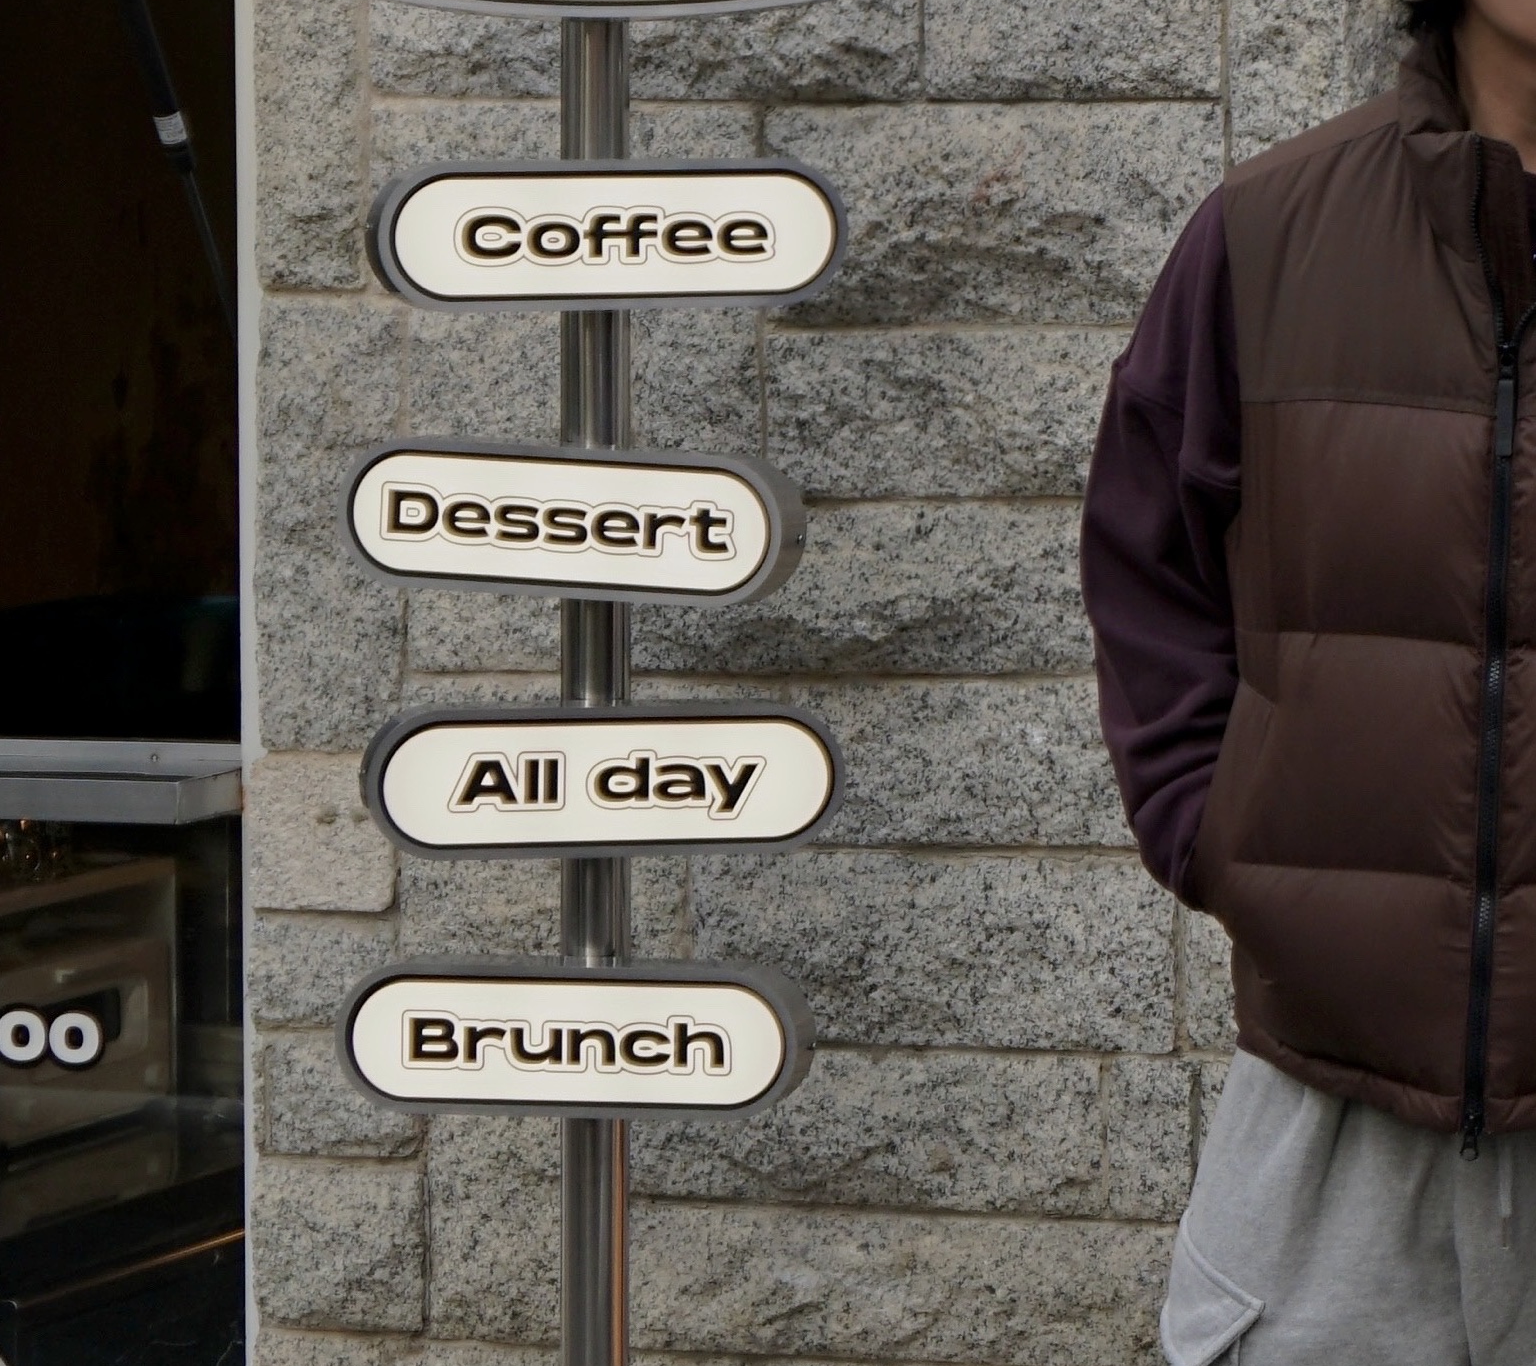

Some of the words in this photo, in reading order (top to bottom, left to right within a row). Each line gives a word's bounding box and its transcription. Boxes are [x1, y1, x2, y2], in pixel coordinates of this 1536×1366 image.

[459, 211, 773, 262] Coffee
[385, 488, 730, 554] Dessert
[456, 758, 560, 806] All
[594, 754, 760, 815] day
[408, 1016, 726, 1068] Brunch
